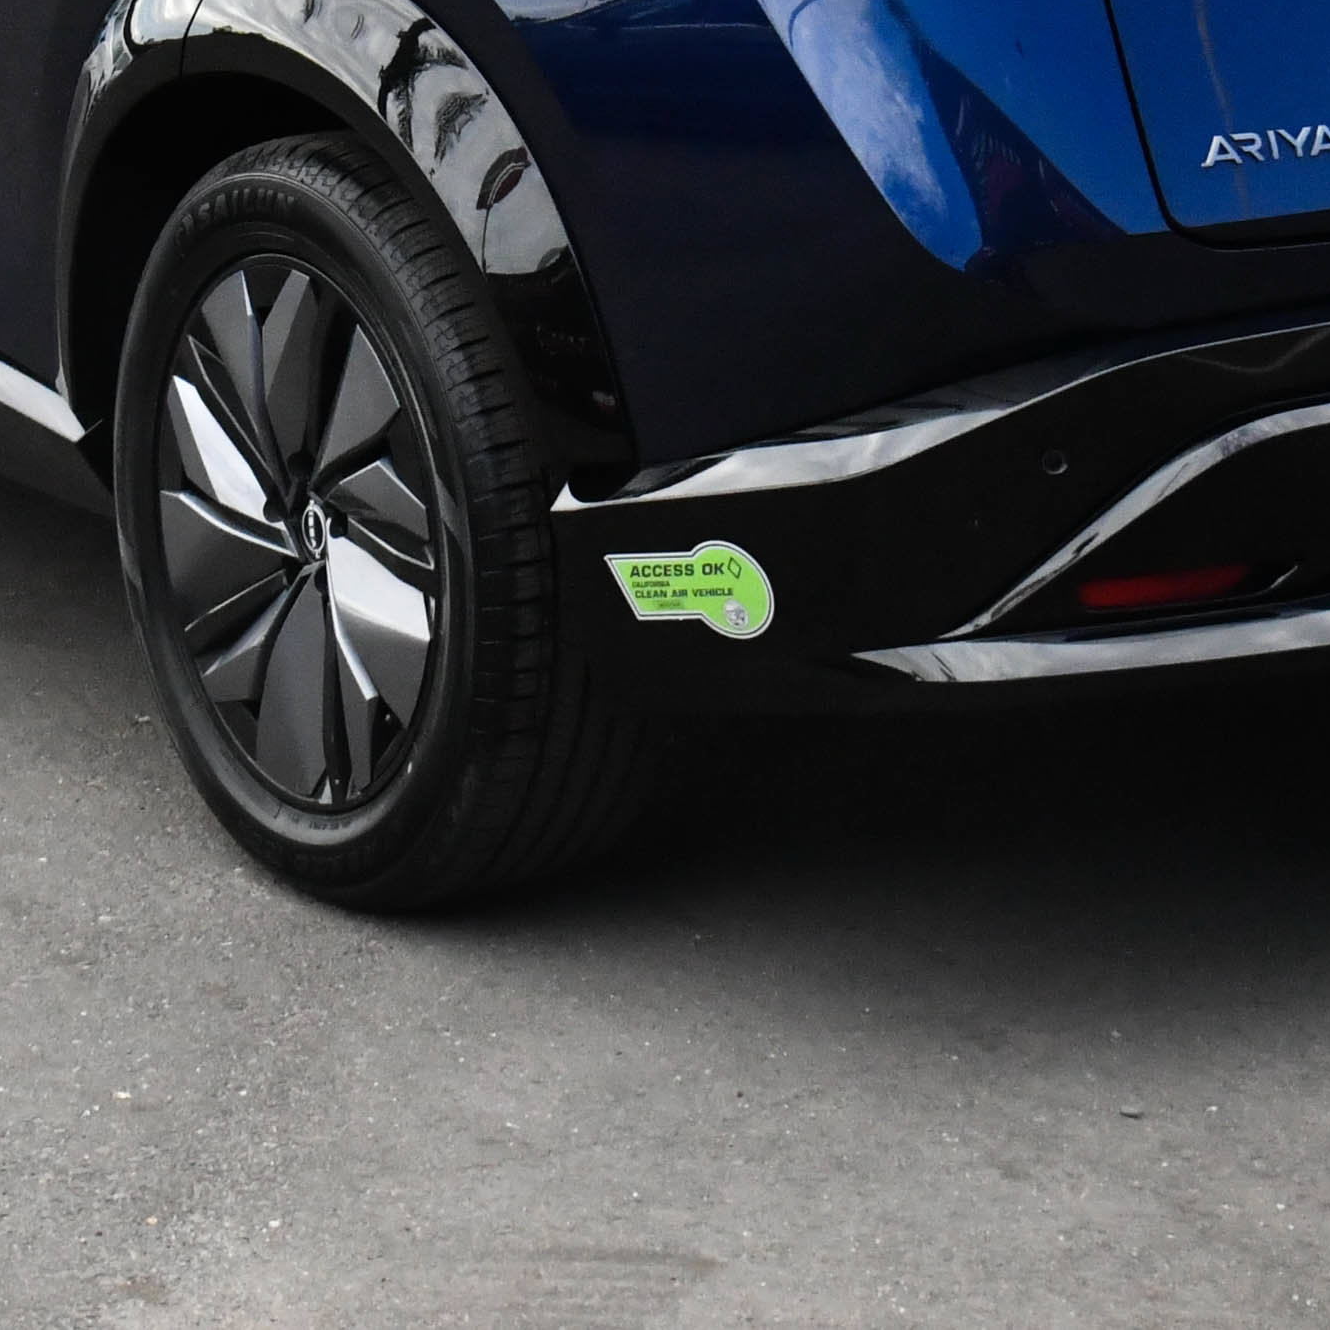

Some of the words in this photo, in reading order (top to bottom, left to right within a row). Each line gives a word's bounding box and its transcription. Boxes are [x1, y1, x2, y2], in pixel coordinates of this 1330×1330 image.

[630, 563, 695, 578] ACCESS
[701, 562, 725, 576] OK
[635, 589, 668, 599] CLEAN
[671, 588, 688, 598] AIR
[692, 587, 733, 598] VEHICLE
